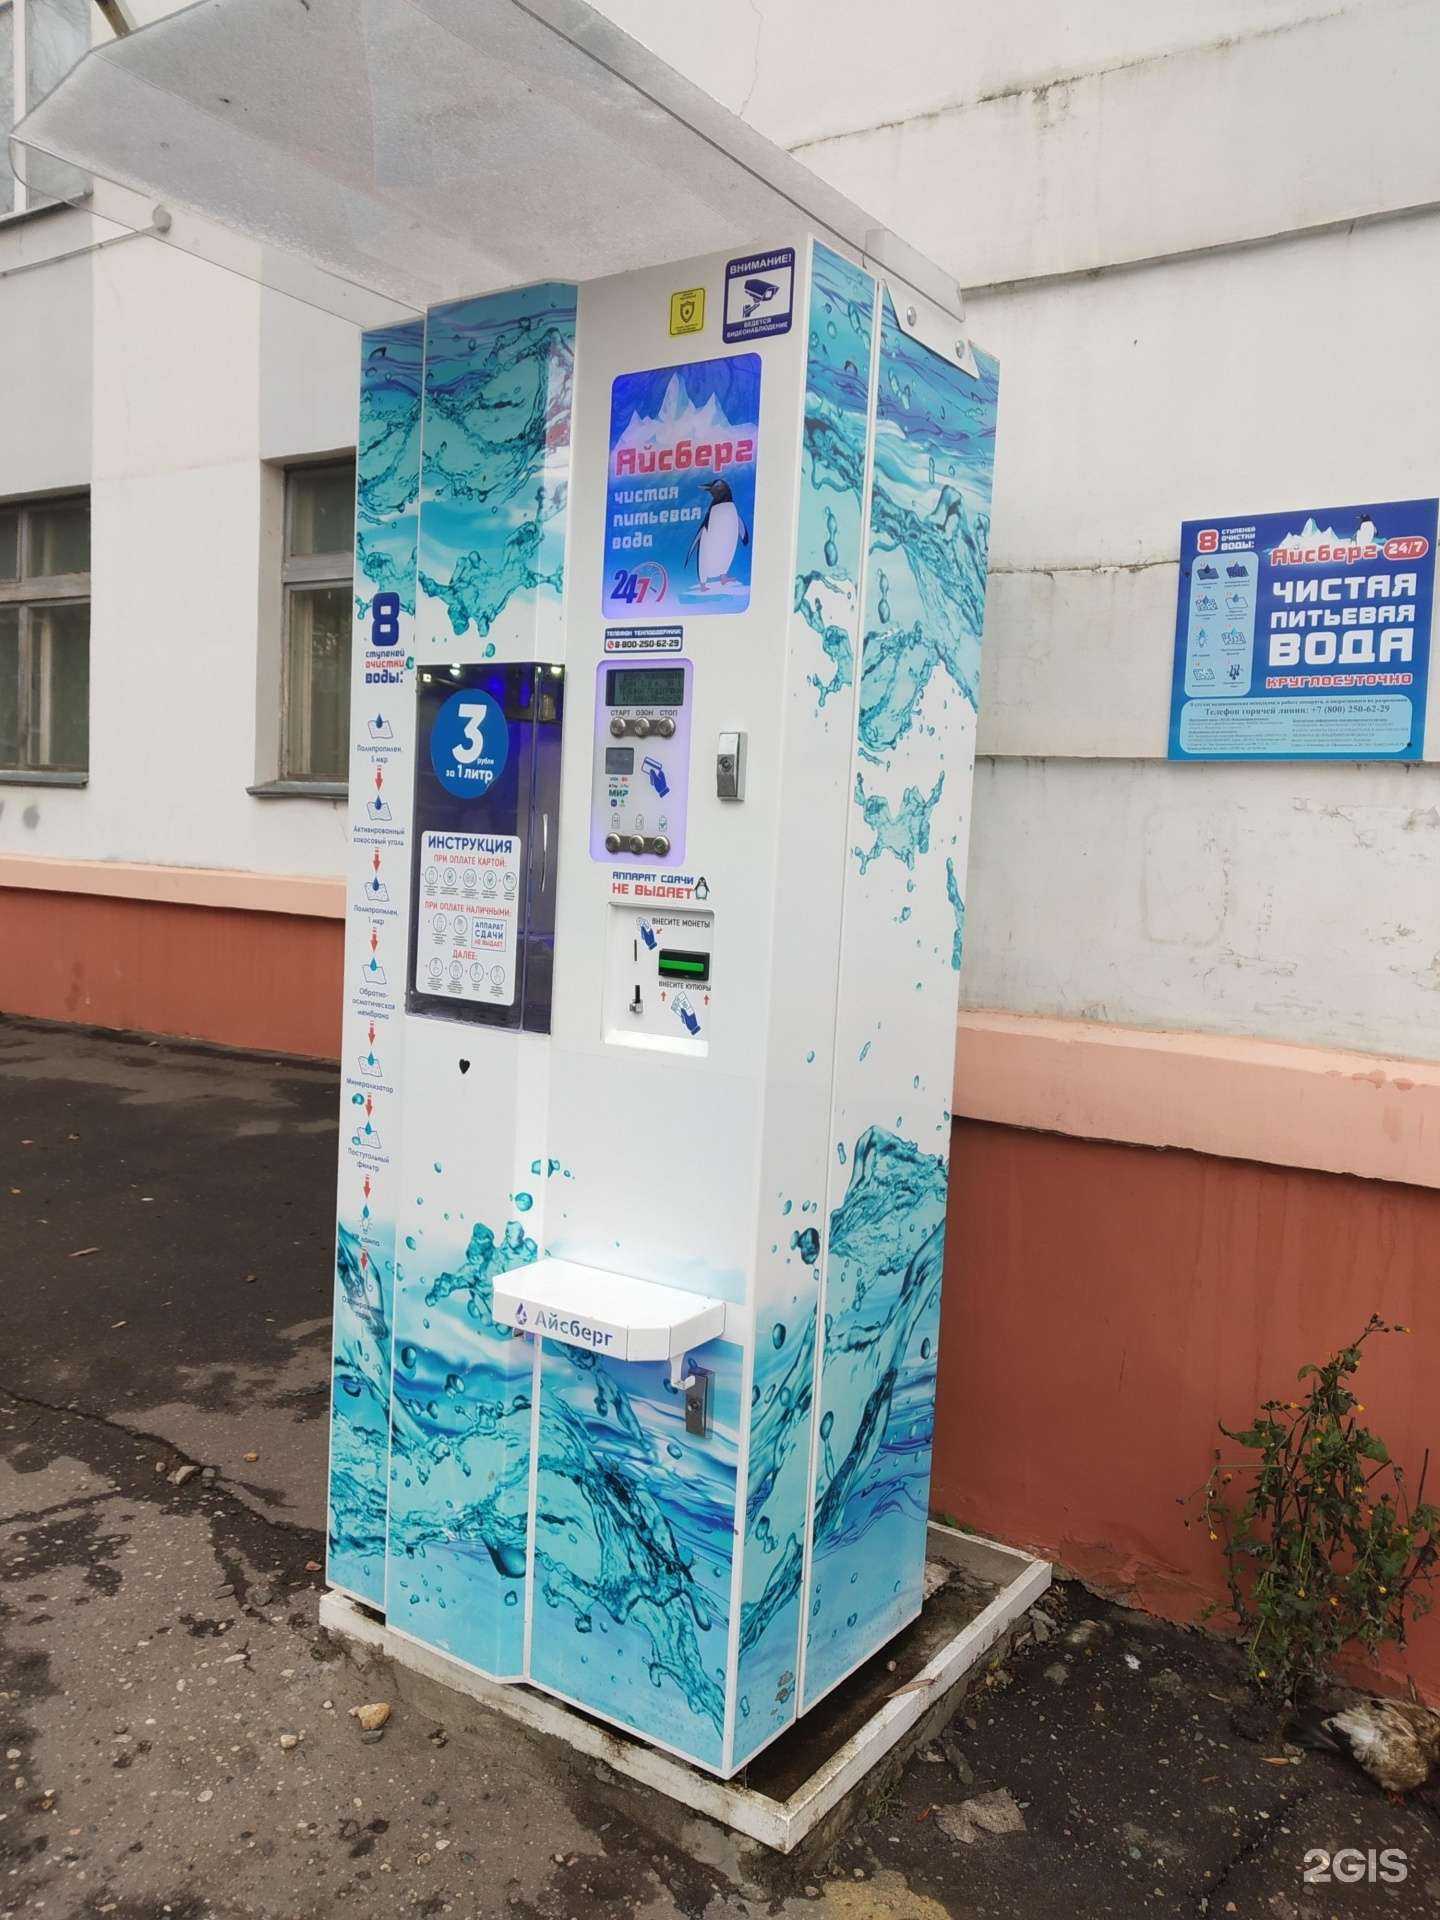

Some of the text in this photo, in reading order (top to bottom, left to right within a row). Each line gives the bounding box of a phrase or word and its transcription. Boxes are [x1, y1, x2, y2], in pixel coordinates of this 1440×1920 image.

[730, 253, 792, 274] ВНИМАНИЕ!
[726, 321, 788, 338] ВИДЕОНАБЛЮДЕНИЕ
[744, 318, 772, 328] ВЕДЕТСЯ
[615, 439, 754, 476] Айсберг
[614, 486, 680, 504] чистая
[613, 506, 703, 527] питьевая
[612, 532, 653, 550] вода
[1197, 529, 1219, 553] 8
[1221, 533, 1256, 542] ОЧИСТКИ
[1221, 541, 1255, 550] ВОДЫ:
[1388, 541, 1423, 555] 24/7
[1270, 543, 1378, 567] Айсберг
[1272, 573, 1417, 603] ЧИСТАЯ
[372, 592, 400, 646] 8
[1270, 605, 1416, 628] ПИТЬЕВАЯ
[365, 649, 405, 659] ступеней
[1268, 628, 1414, 666] ВОДА
[365, 660, 405, 669] очистки
[365, 669, 403, 683] воды:
[1266, 674, 1413, 689] КРУГЛОСУТОЧНО
[1205, 708, 1240, 717] Телефон
[1242, 708, 1276, 717] горячей
[1311, 705, 1322, 713] +7
[1324, 704, 1346, 714] (800)
[452, 703, 488, 764] 3
[445, 764, 494, 784] за 1 литр
[609, 789, 629, 797] МИР
[428, 836, 512, 854] ИНСТРУКЦИЯ
[433, 854, 448, 864] ПРИ
[449, 855, 476, 865] ОПЛАТЕ
[612, 871, 694, 885] АППАРАТ СДАЧИ
[612, 883, 694, 899] НЕ ВЫДАЕТ
[425, 901, 438, 910] ПРИ
[439, 902, 465, 912] ОПЛАТЕ
[475, 922, 504, 930] АППАРАТ
[652, 917, 711, 928] ВНЕСИТЕ МОНЕТЫ
[475, 930, 504, 940] СДАЧИ
[658, 981, 711, 991] ВНЕСИТЕ КУПЮРЫ
[535, 1311, 613, 1347] Айсберг
